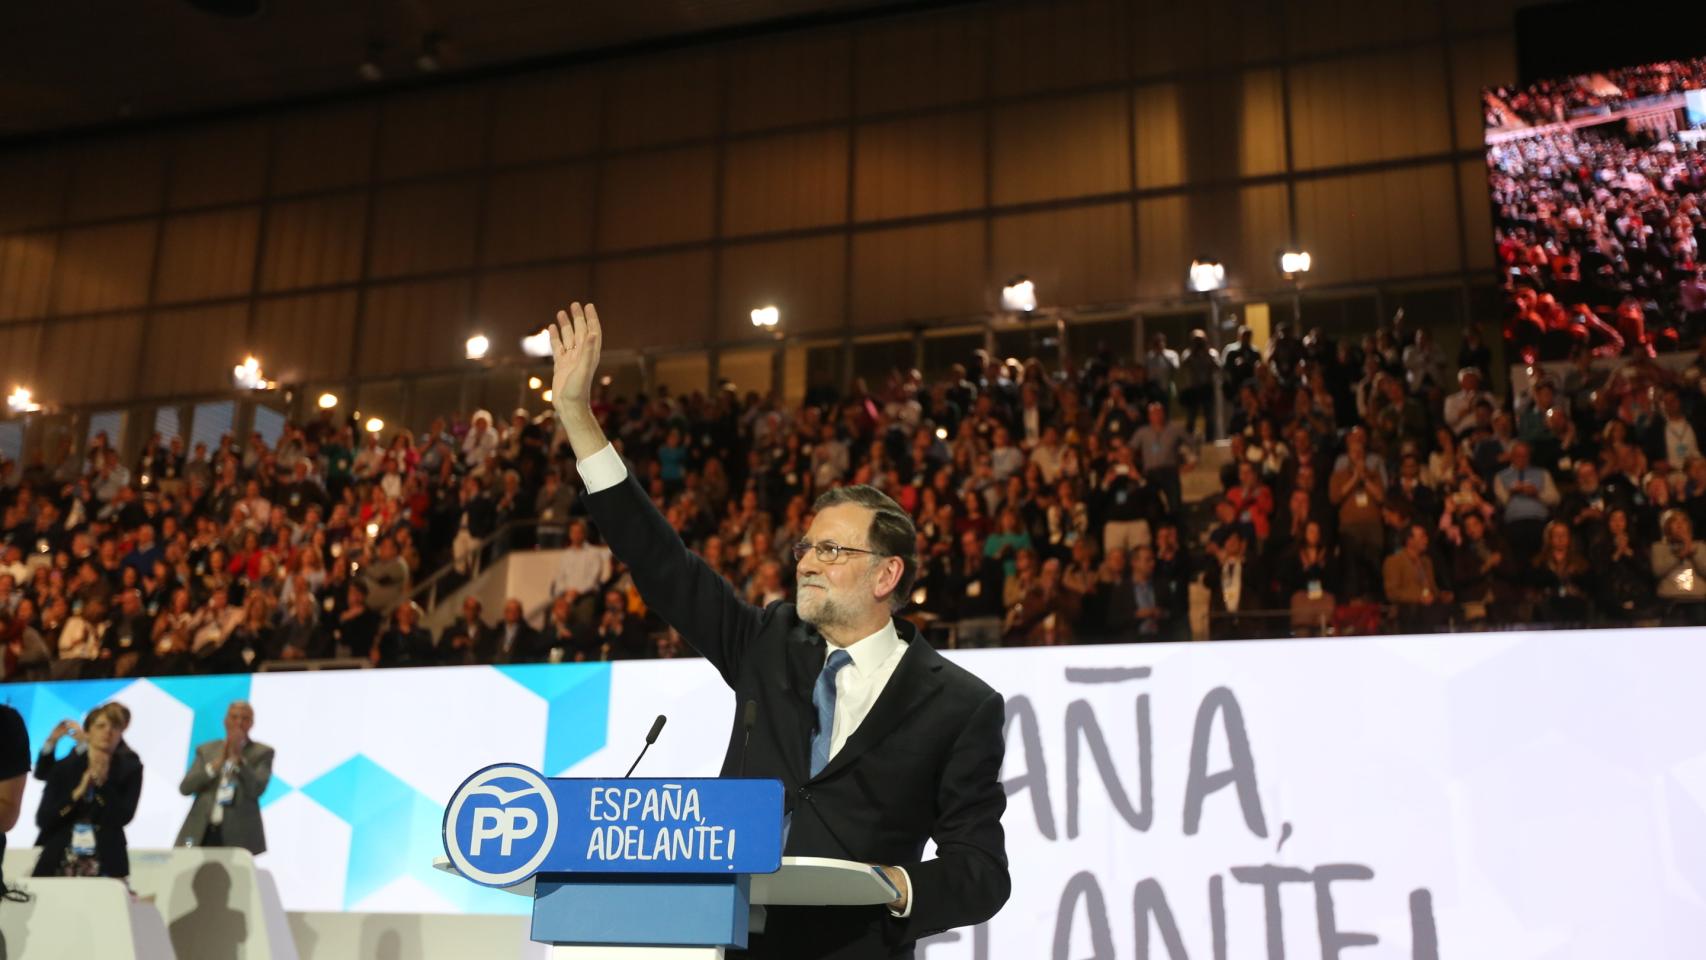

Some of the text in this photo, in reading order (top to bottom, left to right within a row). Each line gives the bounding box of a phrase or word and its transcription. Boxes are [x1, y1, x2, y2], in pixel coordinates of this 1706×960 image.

[997, 666, 1293, 851] AÑA,
[588, 783, 706, 825] ESPAÑA,
[469, 807, 538, 857] PP
[586, 825, 736, 870] ADELANTE!
